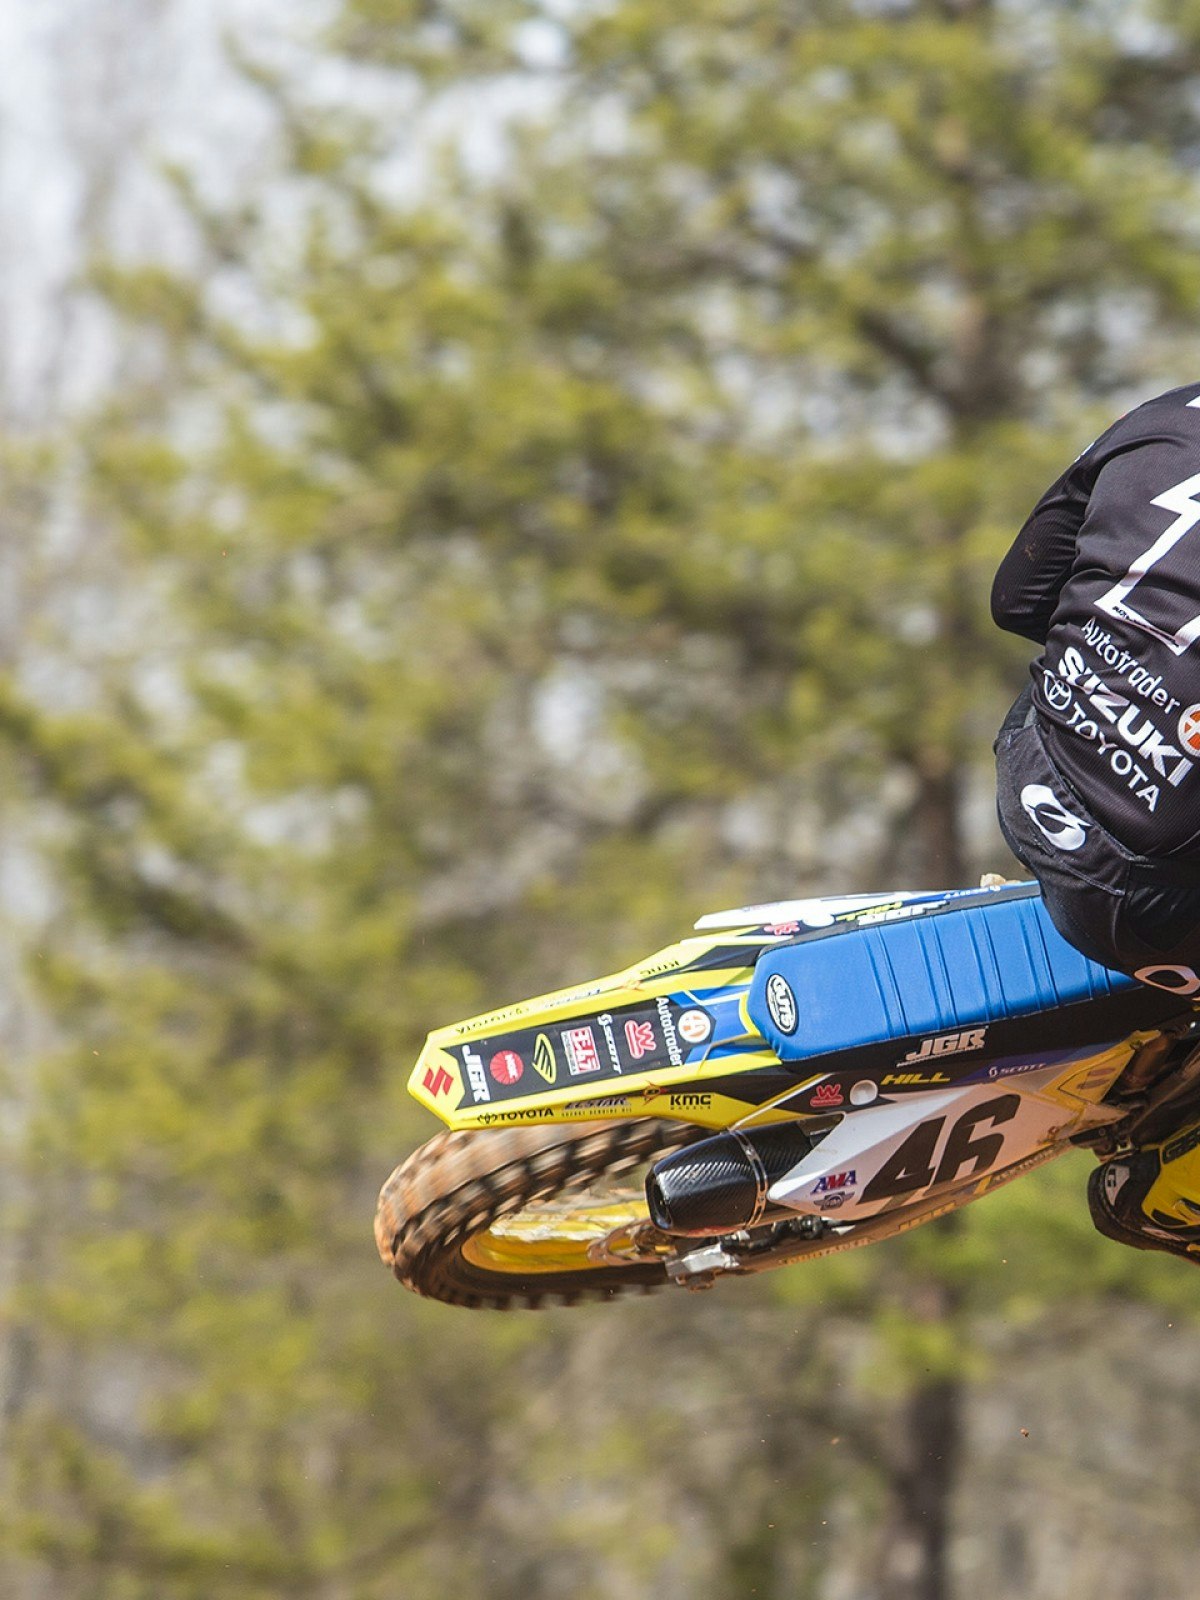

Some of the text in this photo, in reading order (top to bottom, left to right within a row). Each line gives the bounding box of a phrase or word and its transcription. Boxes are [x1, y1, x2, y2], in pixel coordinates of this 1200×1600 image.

[1081, 616, 1180, 714] Autotrader
[1065, 702, 1160, 812] TOYOTA
[602, 1026, 622, 1074] SCOTT
[655, 996, 684, 1067] Autotrader
[906, 1028, 987, 1060] JGR
[462, 1044, 491, 1102] JGR
[881, 1072, 951, 1086] HILL
[498, 1107, 554, 1122] TOYOTA
[670, 1094, 711, 1107] KMC
[857, 1094, 1021, 1205] 46
[810, 1170, 857, 1196] AMA
